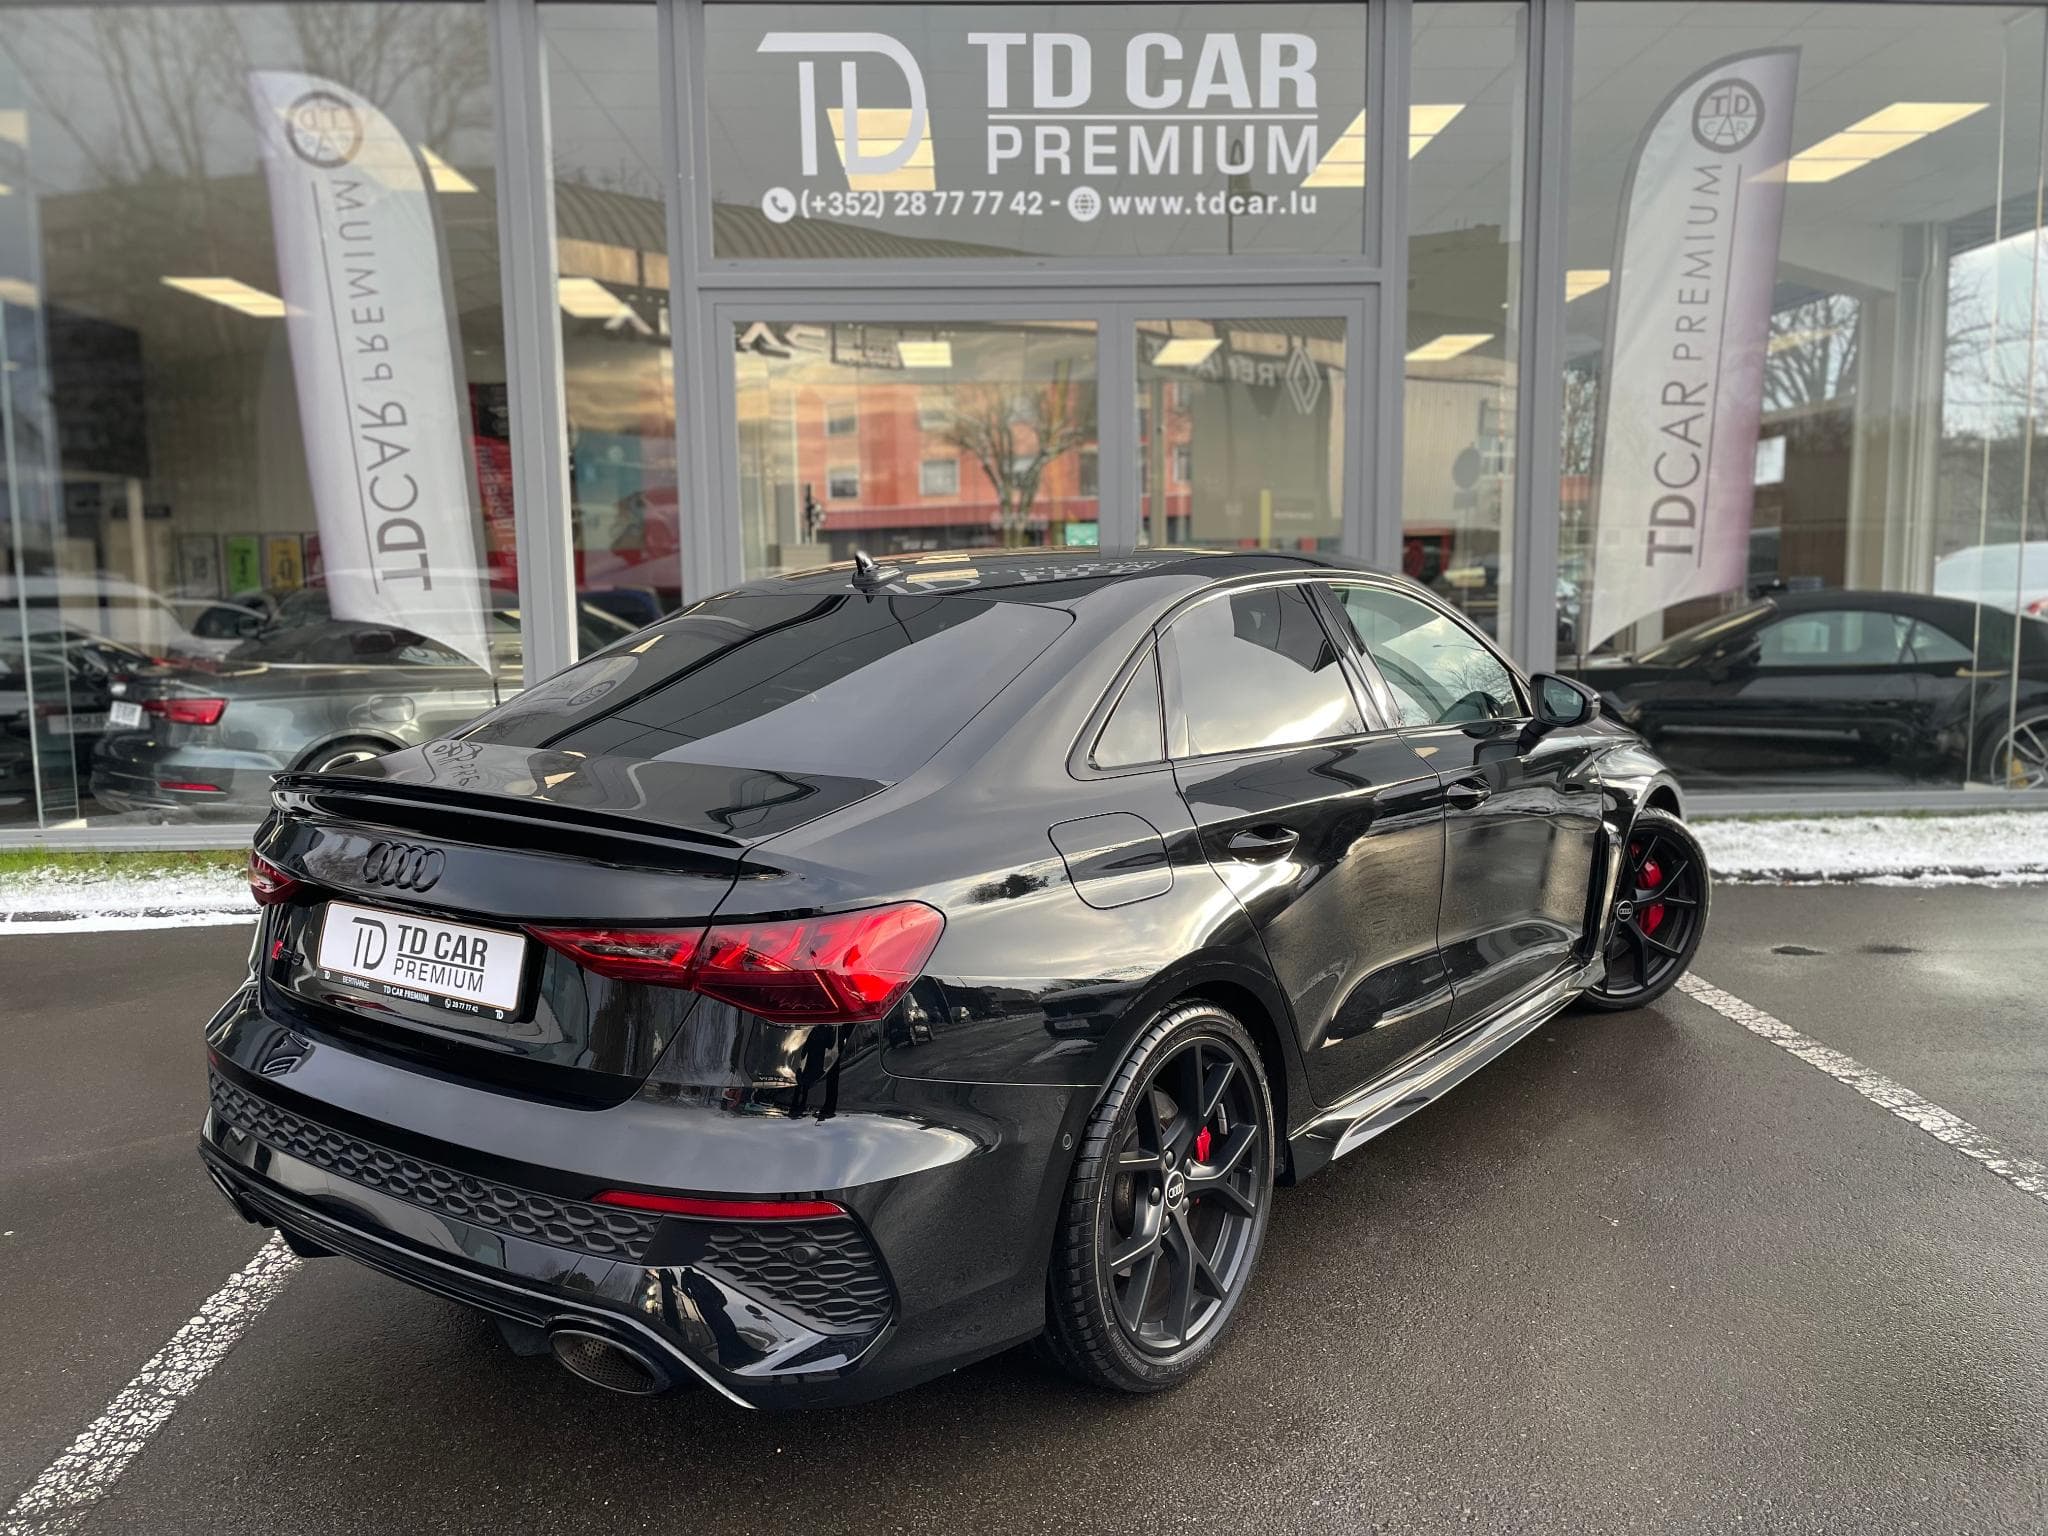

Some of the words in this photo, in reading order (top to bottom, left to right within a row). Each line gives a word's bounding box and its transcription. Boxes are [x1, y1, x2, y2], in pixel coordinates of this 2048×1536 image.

[968, 33, 1092, 109] TD
[1126, 33, 1318, 109] CAR
[1711, 95, 1750, 114] TD
[988, 126, 1318, 175] PREMIUM
[801, 191, 885, 218] (+352)
[895, 192, 926, 215] 28
[933, 192, 963, 214] 77
[972, 192, 1002, 214] 77
[1010, 192, 1043, 214] 42
[1108, 192, 1318, 215] www.tdcar.lu
[1673, 164, 1724, 361] PREMIUM
[397, 924, 428, 955] TD
[434, 931, 488, 967] CAR
[393, 958, 484, 993] PREMIUM
